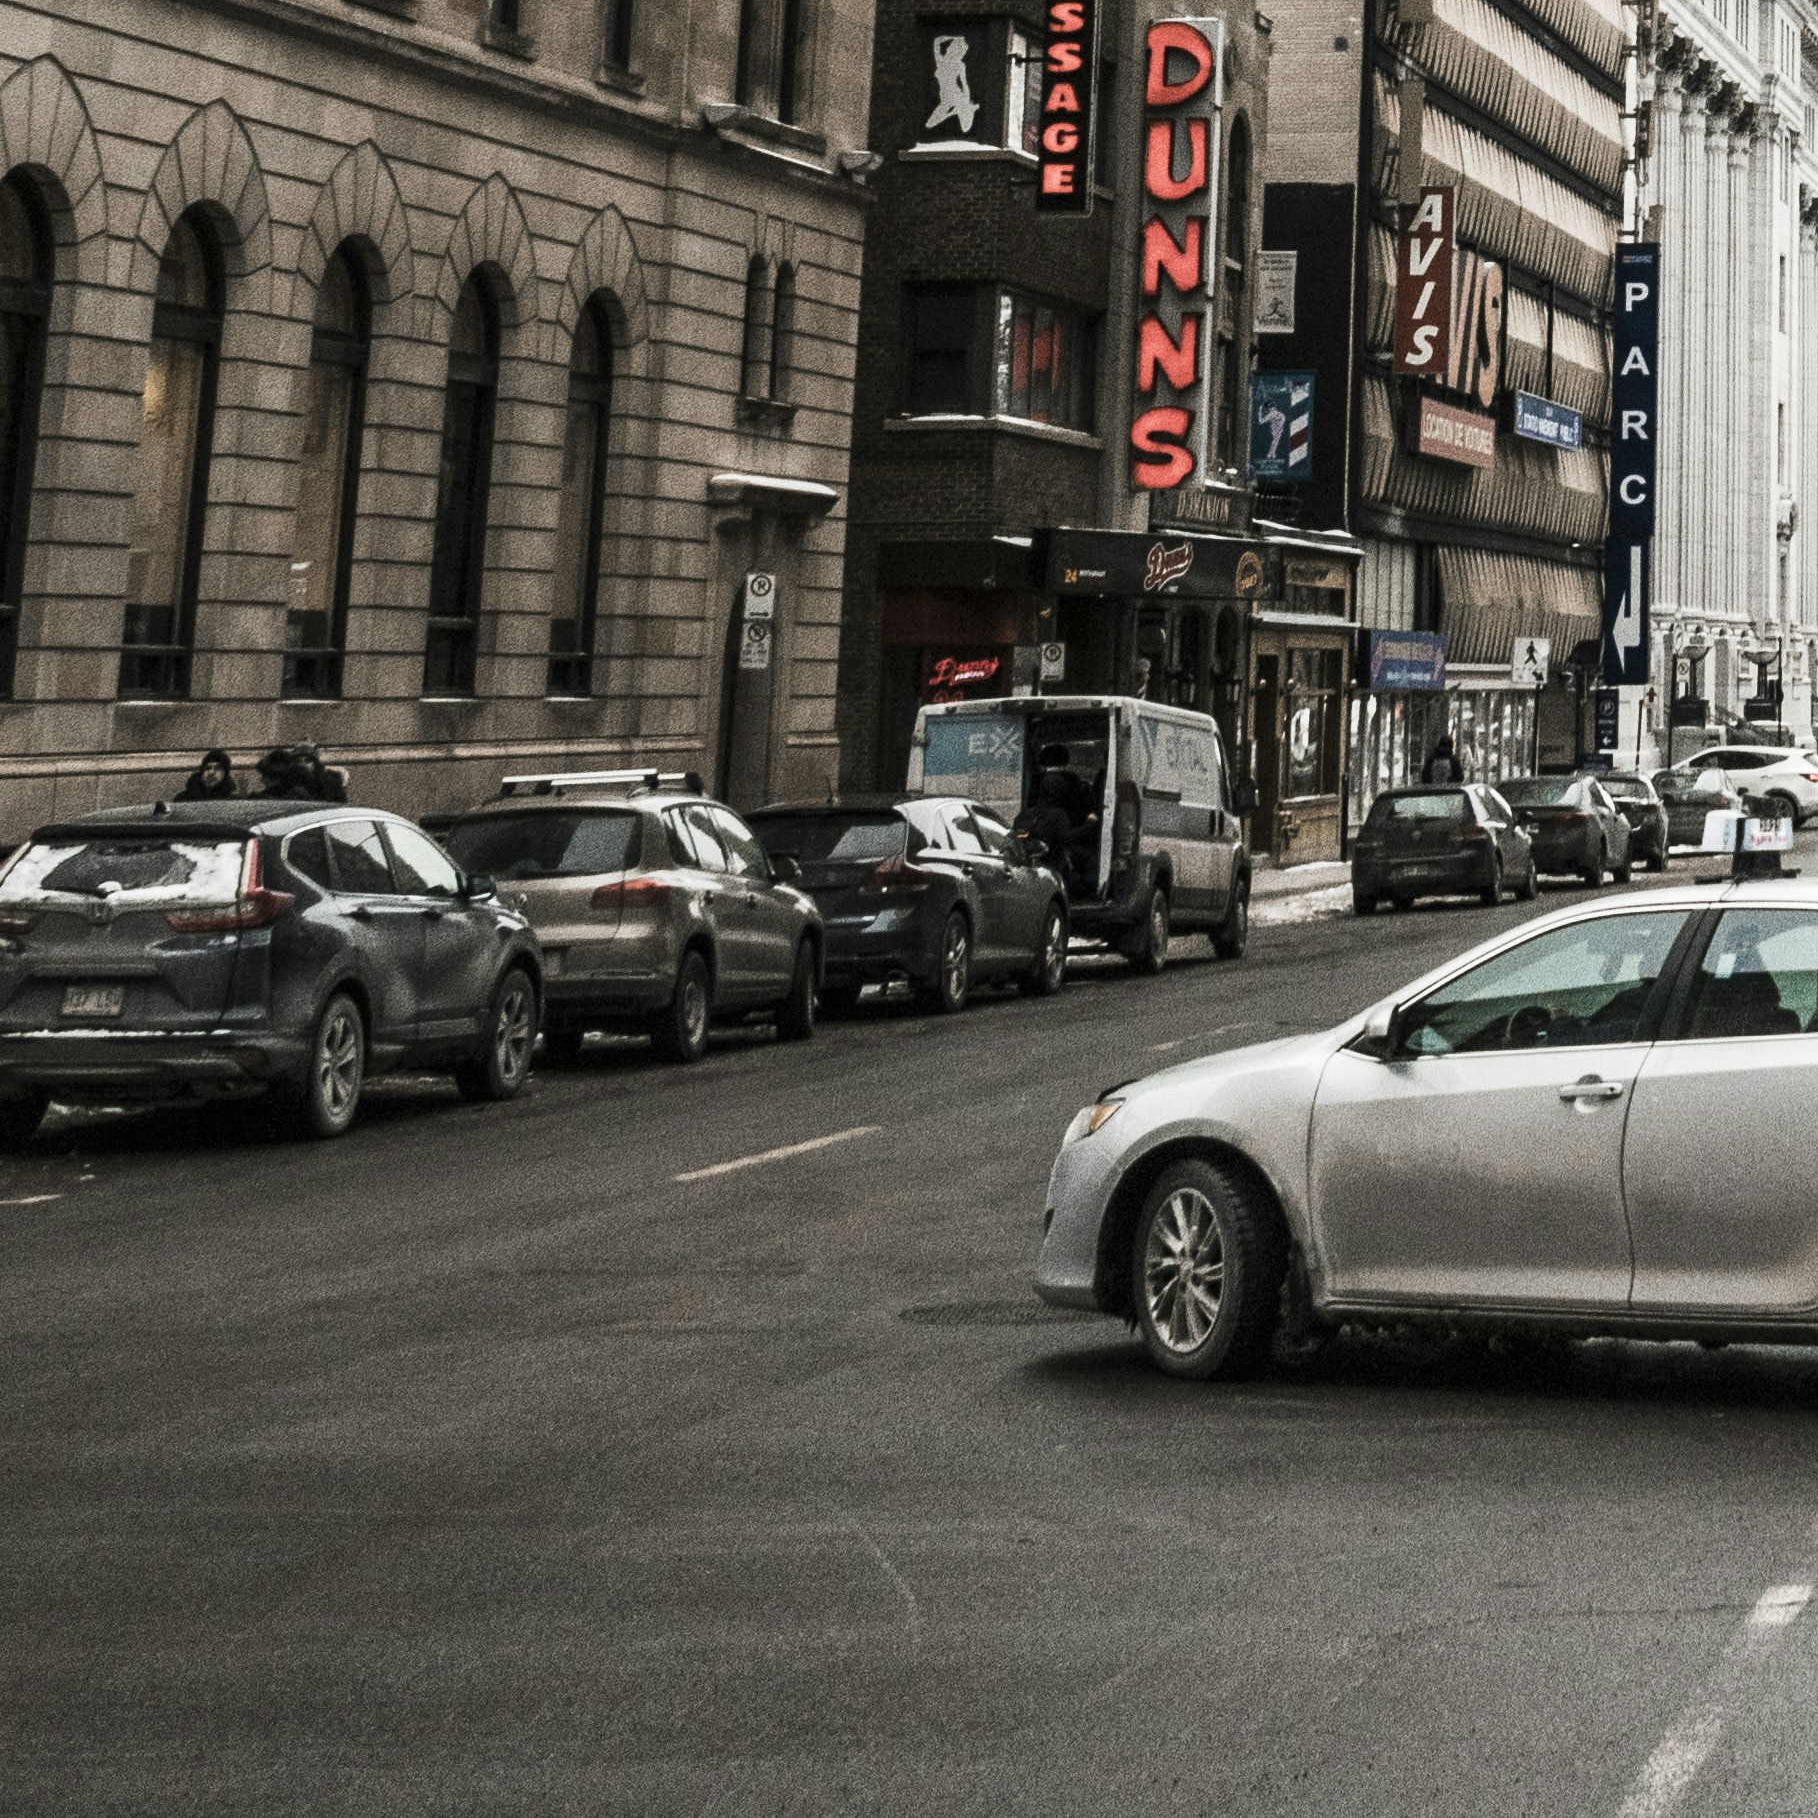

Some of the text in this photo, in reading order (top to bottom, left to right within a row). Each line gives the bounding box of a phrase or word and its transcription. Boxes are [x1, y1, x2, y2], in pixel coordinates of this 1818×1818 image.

[1130, 19, 1214, 490] DUNNS
[1404, 194, 1444, 366] AVIS
[1620, 282, 1649, 506] PARC
